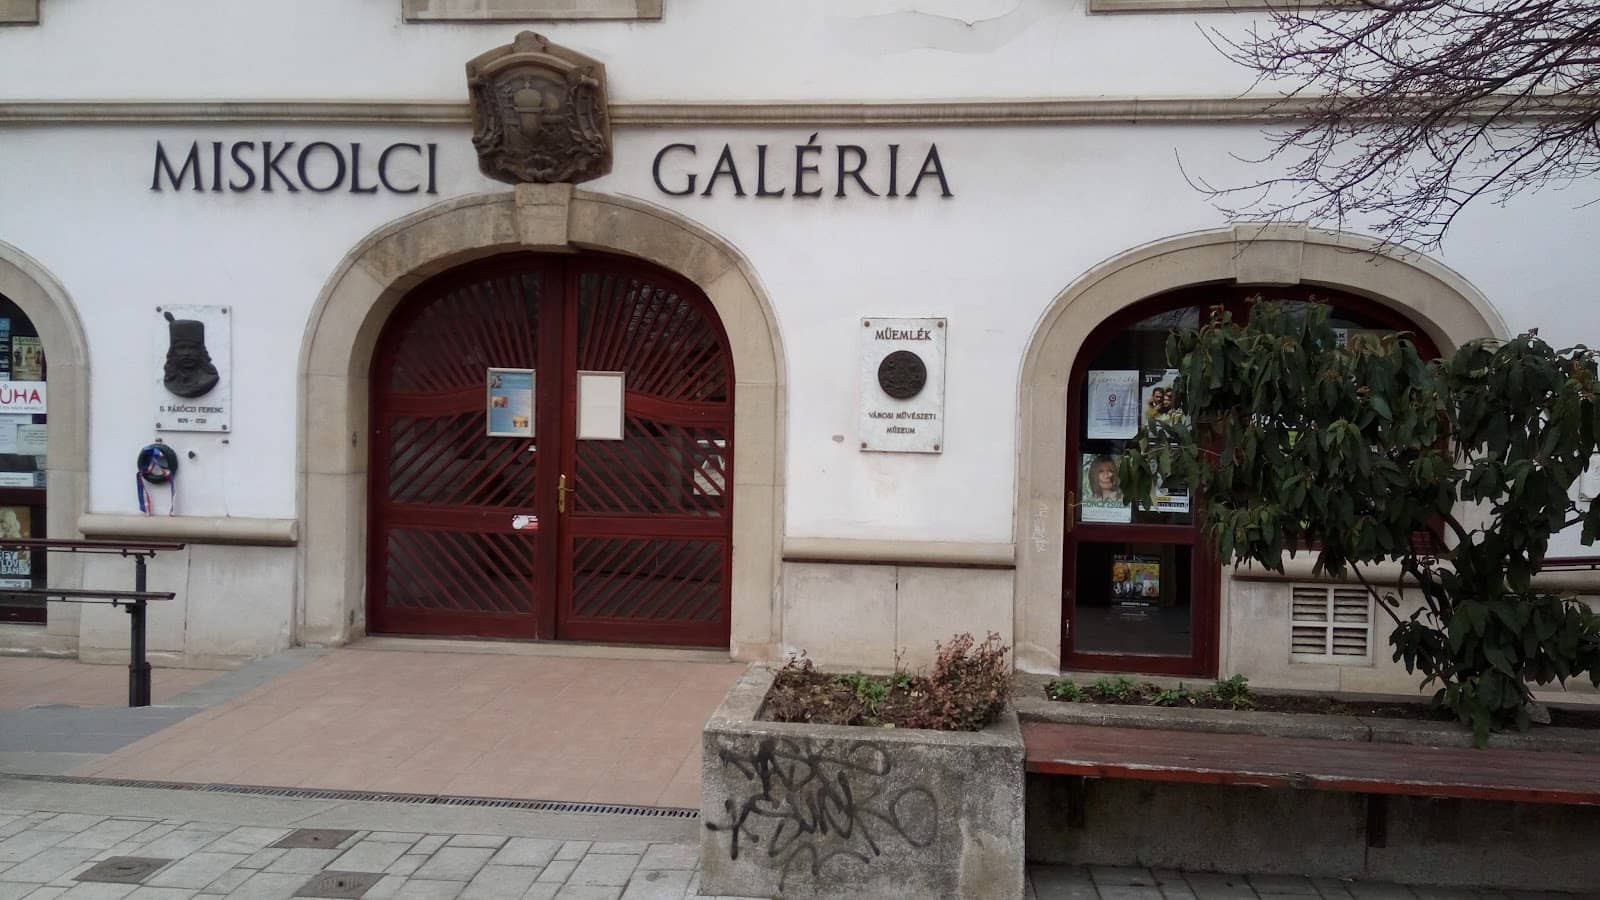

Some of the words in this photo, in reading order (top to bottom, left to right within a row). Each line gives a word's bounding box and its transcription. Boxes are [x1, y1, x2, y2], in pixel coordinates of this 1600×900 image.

[150, 139, 438, 195] MISKOLCI
[651, 132, 954, 197] GALÉRIA
[868, 411, 894, 420] VÁROSI
